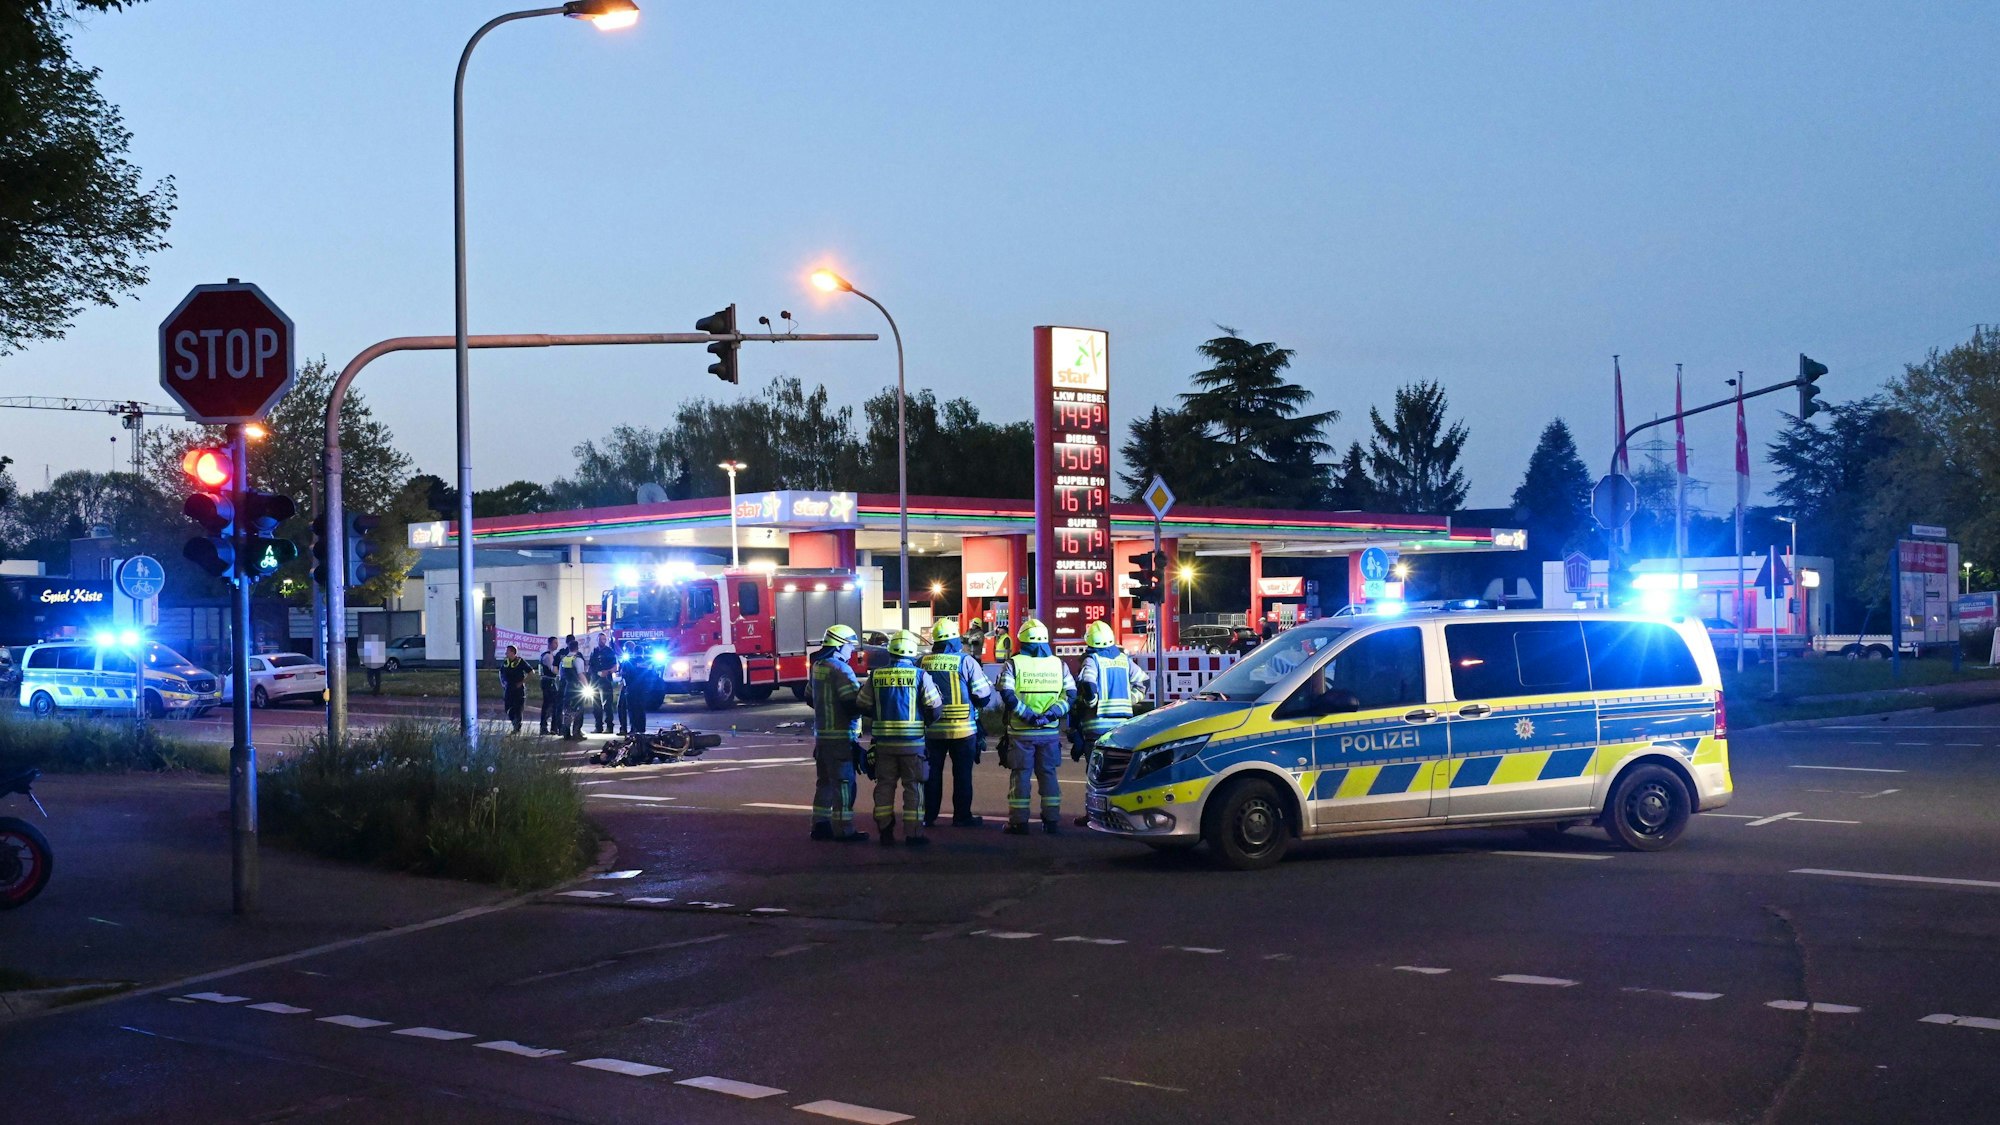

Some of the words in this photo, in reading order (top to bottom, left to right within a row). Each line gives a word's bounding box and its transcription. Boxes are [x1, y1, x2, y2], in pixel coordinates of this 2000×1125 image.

[174, 327, 278, 380] STOP
[1058, 368, 1089, 384] star
[1053, 391, 1075, 402] LKW
[1077, 392, 1106, 403] DIESEL
[1065, 433, 1098, 445] DIESEL
[1057, 475, 1089, 486] SUPER
[1090, 477, 1105, 487] E10
[735, 500, 761, 518] star
[793, 498, 829, 516] star
[1067, 518, 1098, 528] SUPER
[1056, 560, 1087, 570] SUPER
[1087, 560, 1107, 571] PLUS
[969, 581, 984, 590] star
[622, 630, 665, 638] FEUERWEHR
[921, 662, 933, 670] PUL
[933, 662, 939, 670] 2
[873, 677, 889, 686] PUL
[890, 677, 896, 685] 2
[897, 677, 915, 686] ELW
[1340, 729, 1420, 753] POLIZEI
